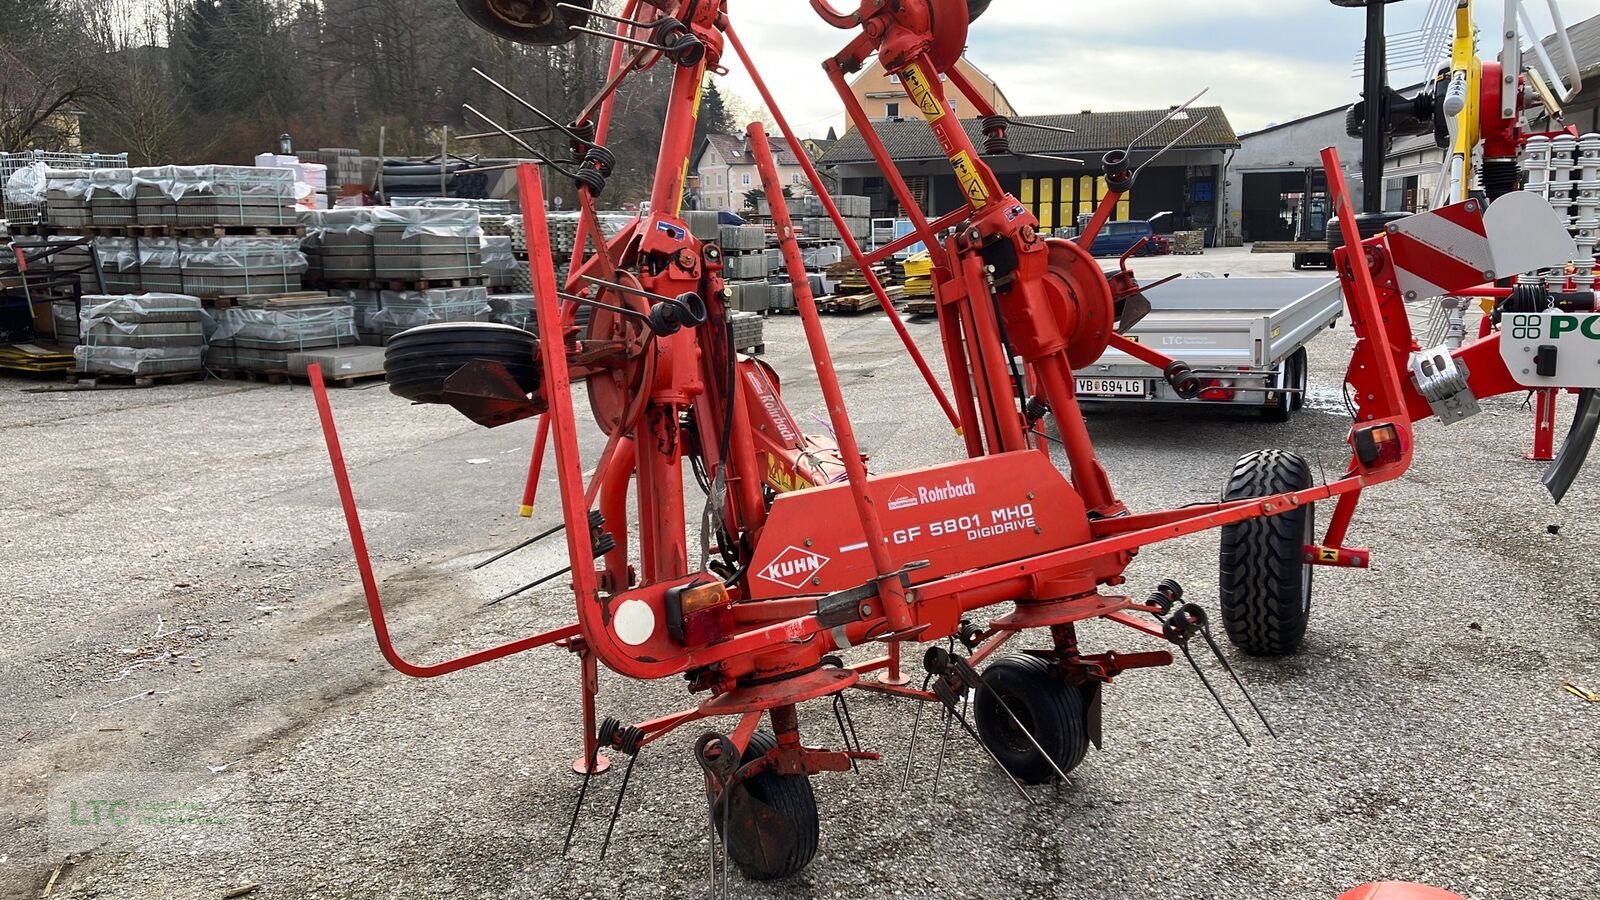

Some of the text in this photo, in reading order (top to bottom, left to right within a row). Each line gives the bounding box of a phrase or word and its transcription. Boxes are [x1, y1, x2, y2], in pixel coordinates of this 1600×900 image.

[1162, 336, 1183, 345] LTC
[1080, 380, 1093, 392] VB
[760, 394, 795, 441] Rohrbach
[918, 476, 976, 504] Rohrbach
[893, 503, 1033, 545] GF 5801 MHO
[967, 517, 1036, 541] DIGIDRIVE
[768, 555, 820, 579] KUHN
